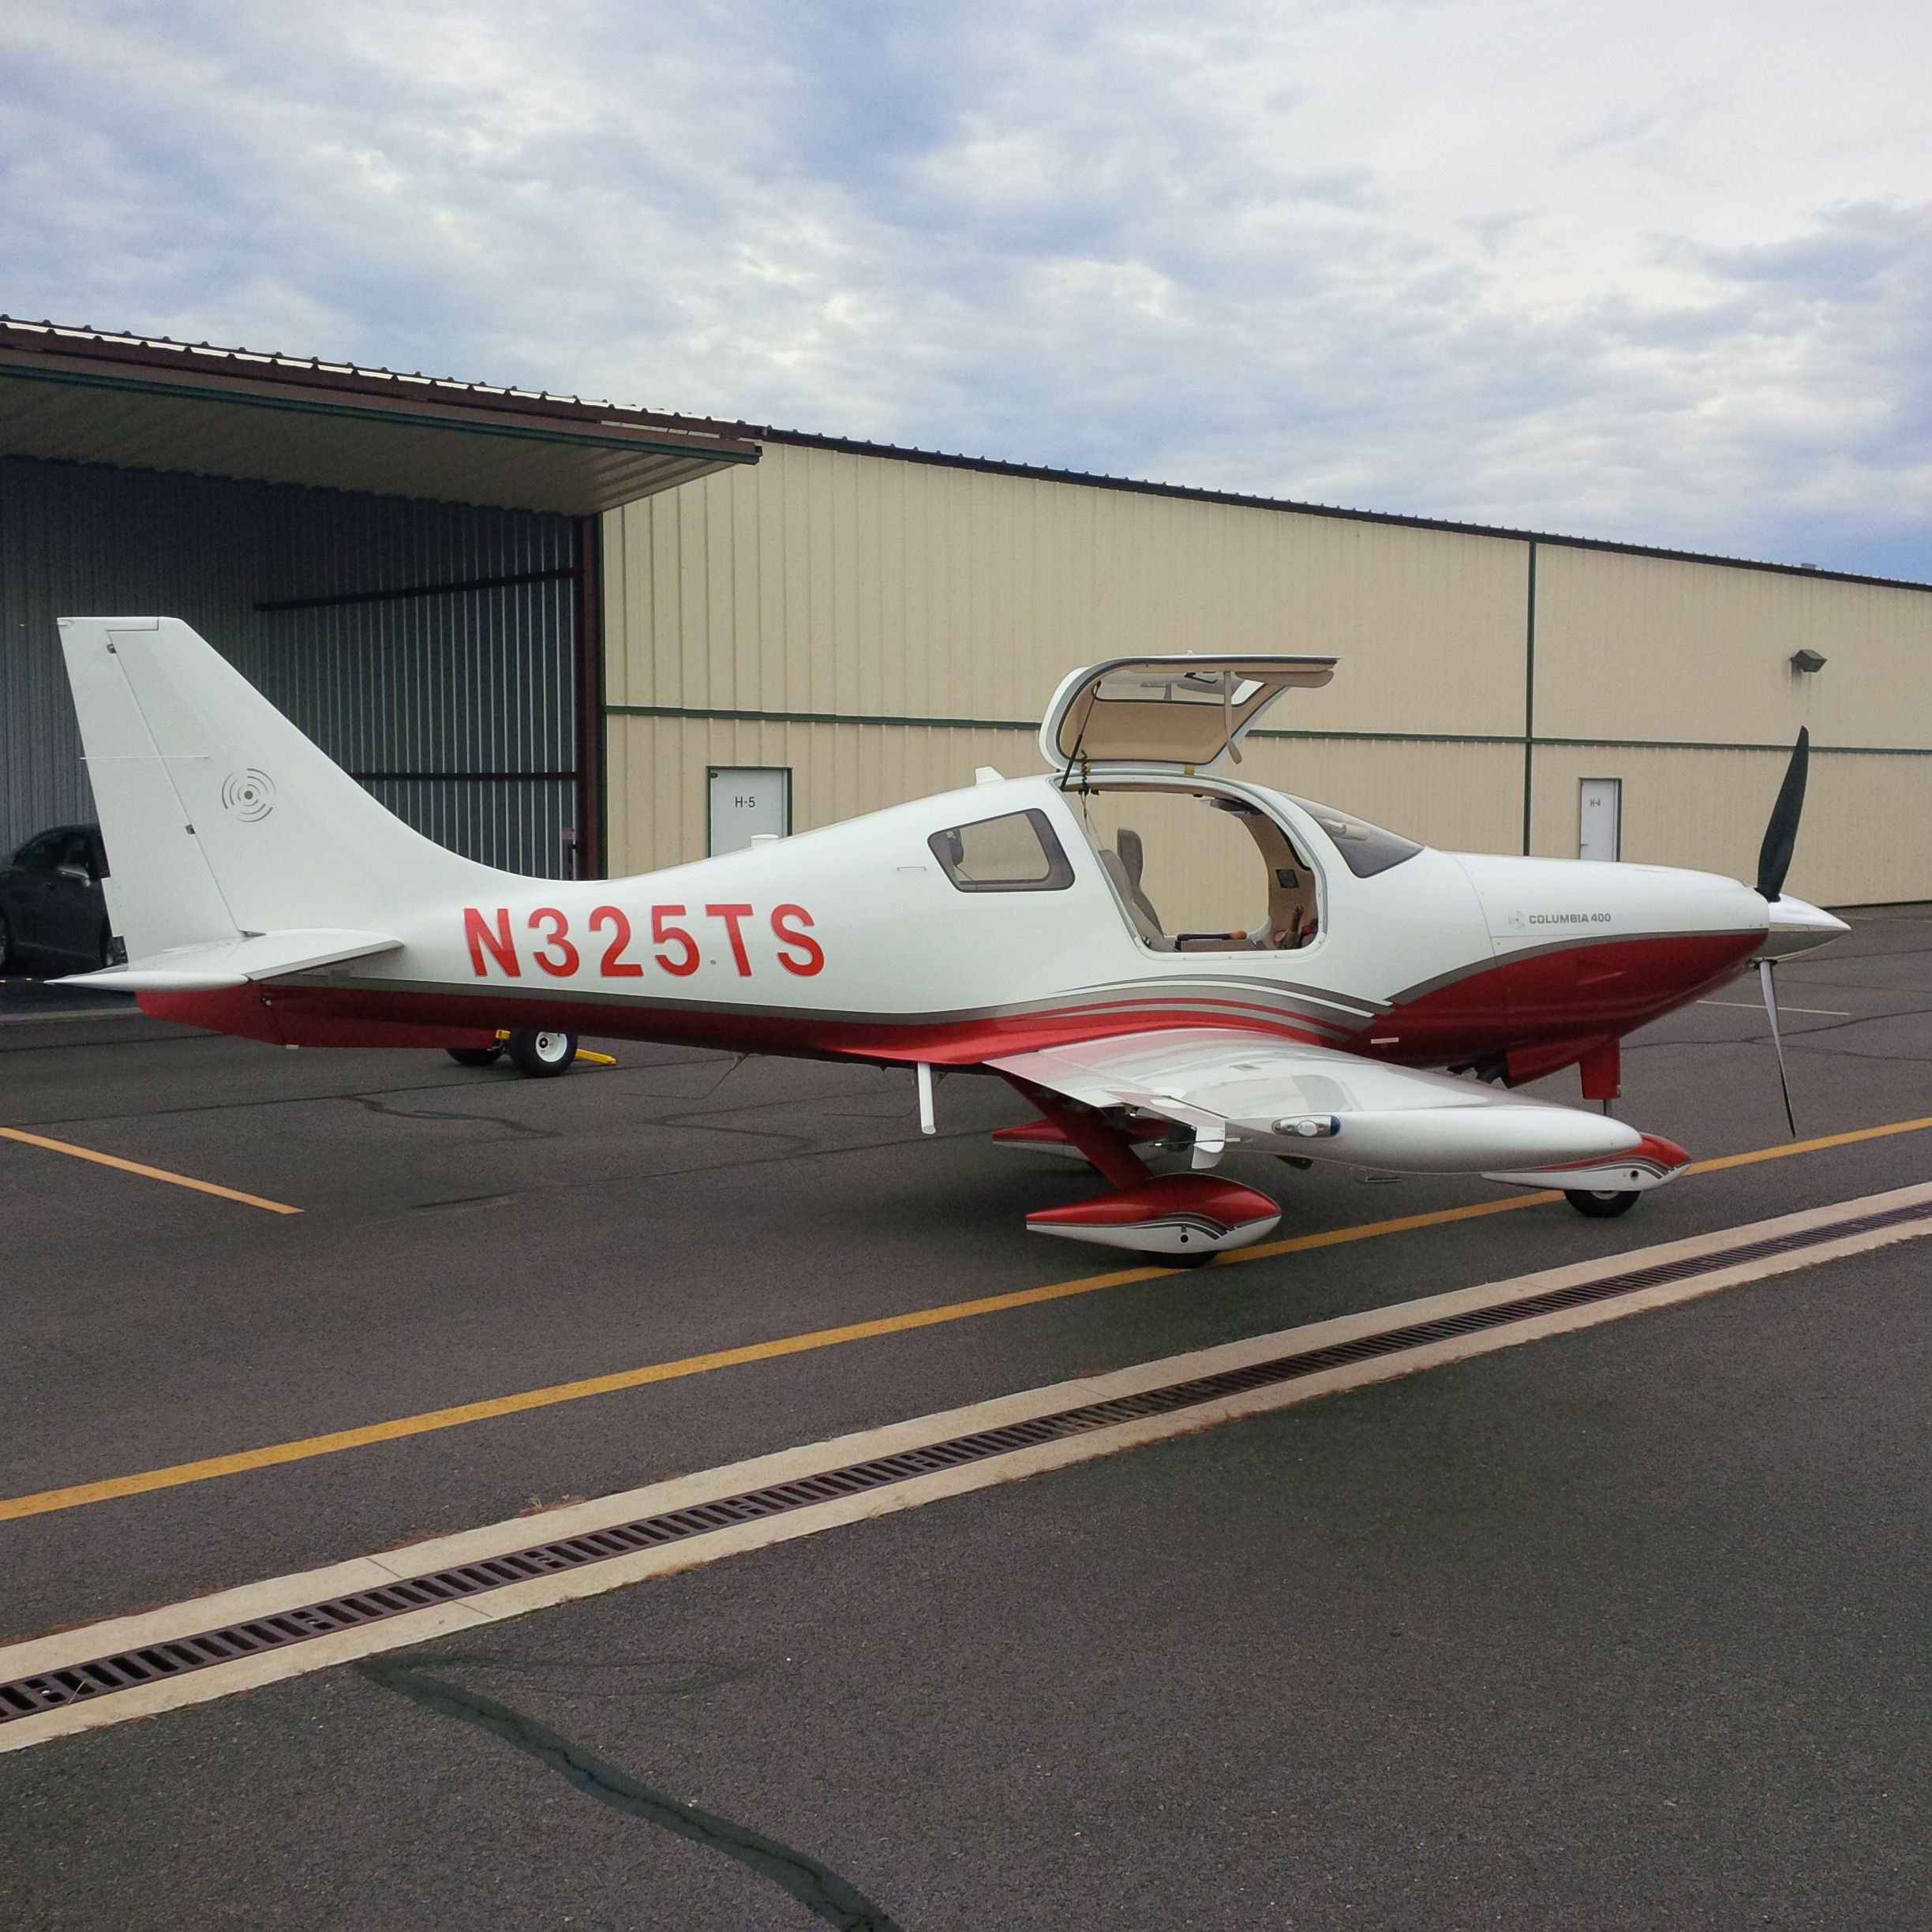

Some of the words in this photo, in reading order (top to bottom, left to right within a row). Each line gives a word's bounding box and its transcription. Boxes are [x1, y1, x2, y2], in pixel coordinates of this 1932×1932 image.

[735, 796, 755, 808] H-5
[1529, 914, 1589, 924] COLUMBIA
[1591, 912, 1612, 923] 400
[463, 903, 826, 979] N325TS
